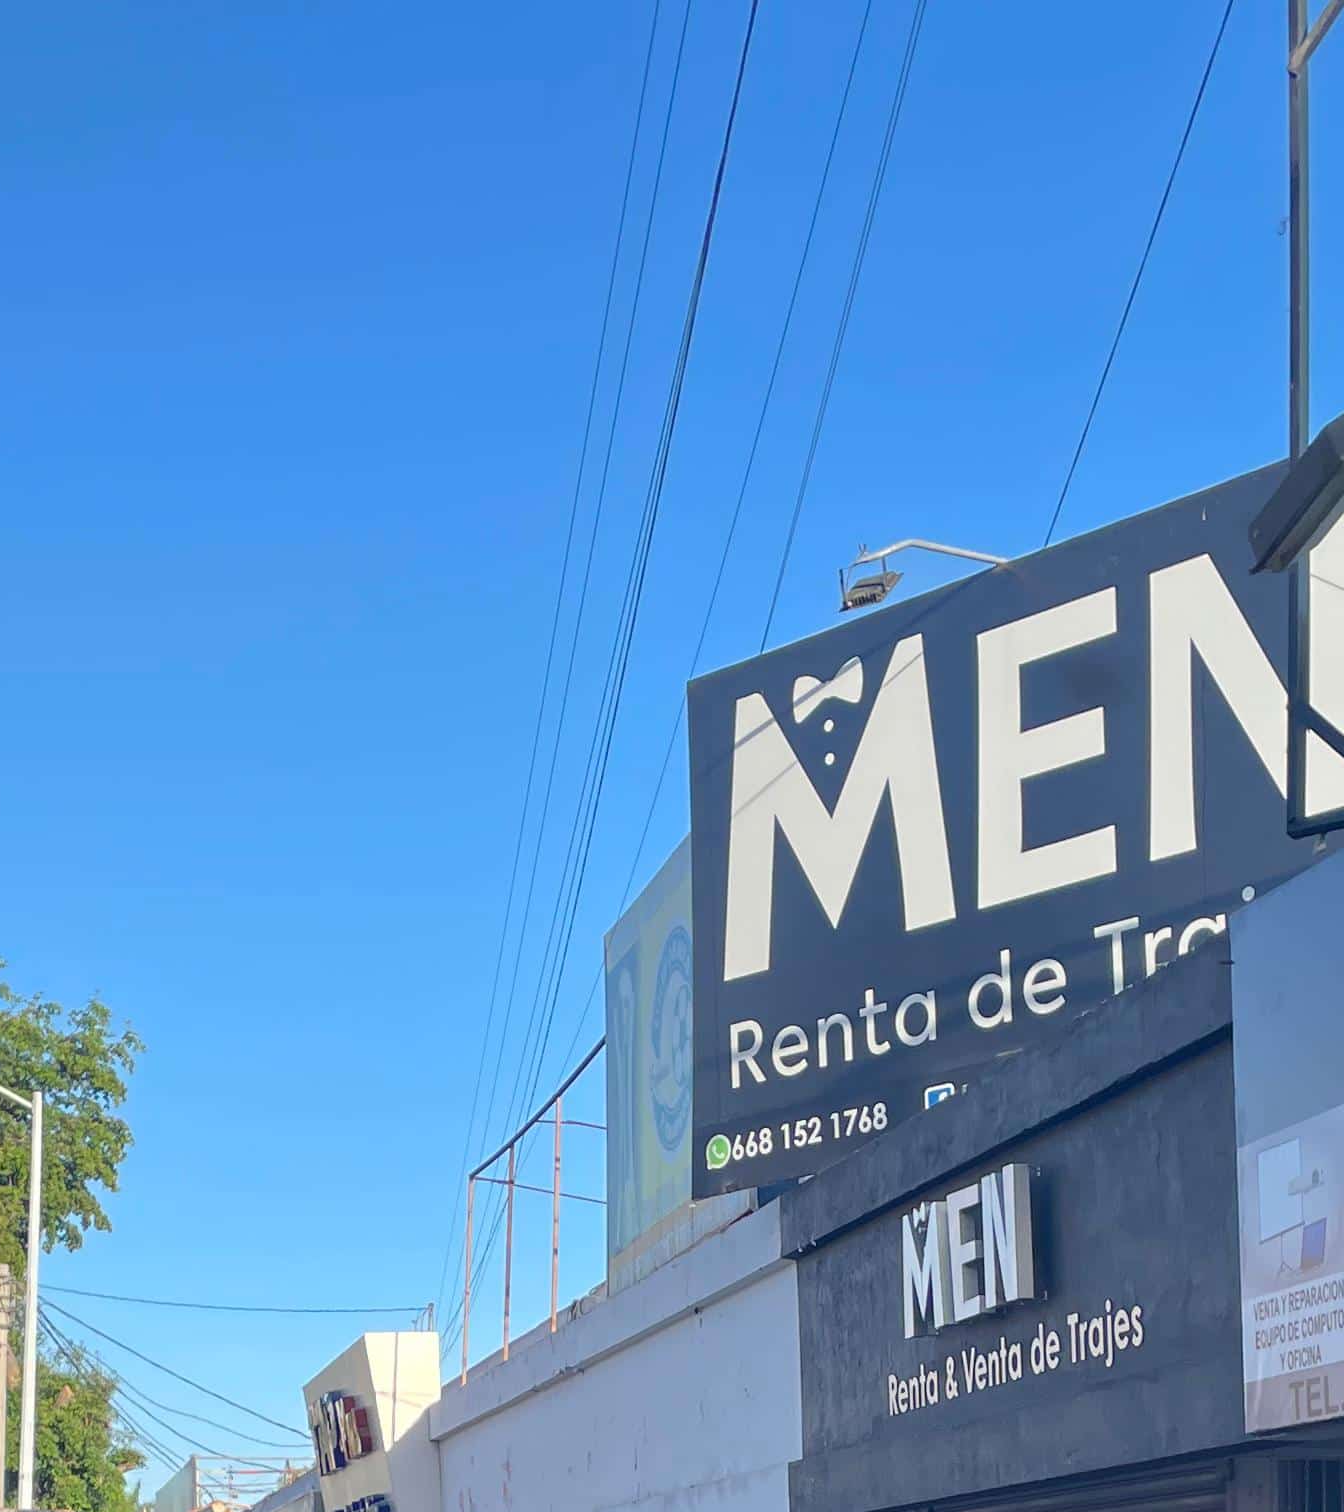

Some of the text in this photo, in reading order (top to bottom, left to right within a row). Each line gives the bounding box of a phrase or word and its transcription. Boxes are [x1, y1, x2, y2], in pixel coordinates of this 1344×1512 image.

[729, 986, 936, 1089] Renta
[968, 949, 1067, 1029] de
[731, 1102, 888, 1162] 668 152 1768
[902, 1162, 1034, 1339] MEN
[1253, 1279, 1344, 1321] VENTA Y REPARACION
[1255, 1309, 1344, 1350] EQUIPO DE COMPUTO
[889, 1299, 1144, 1416] Renta & Venta de Trajes
[1279, 1344, 1322, 1371] Y OFICINA
